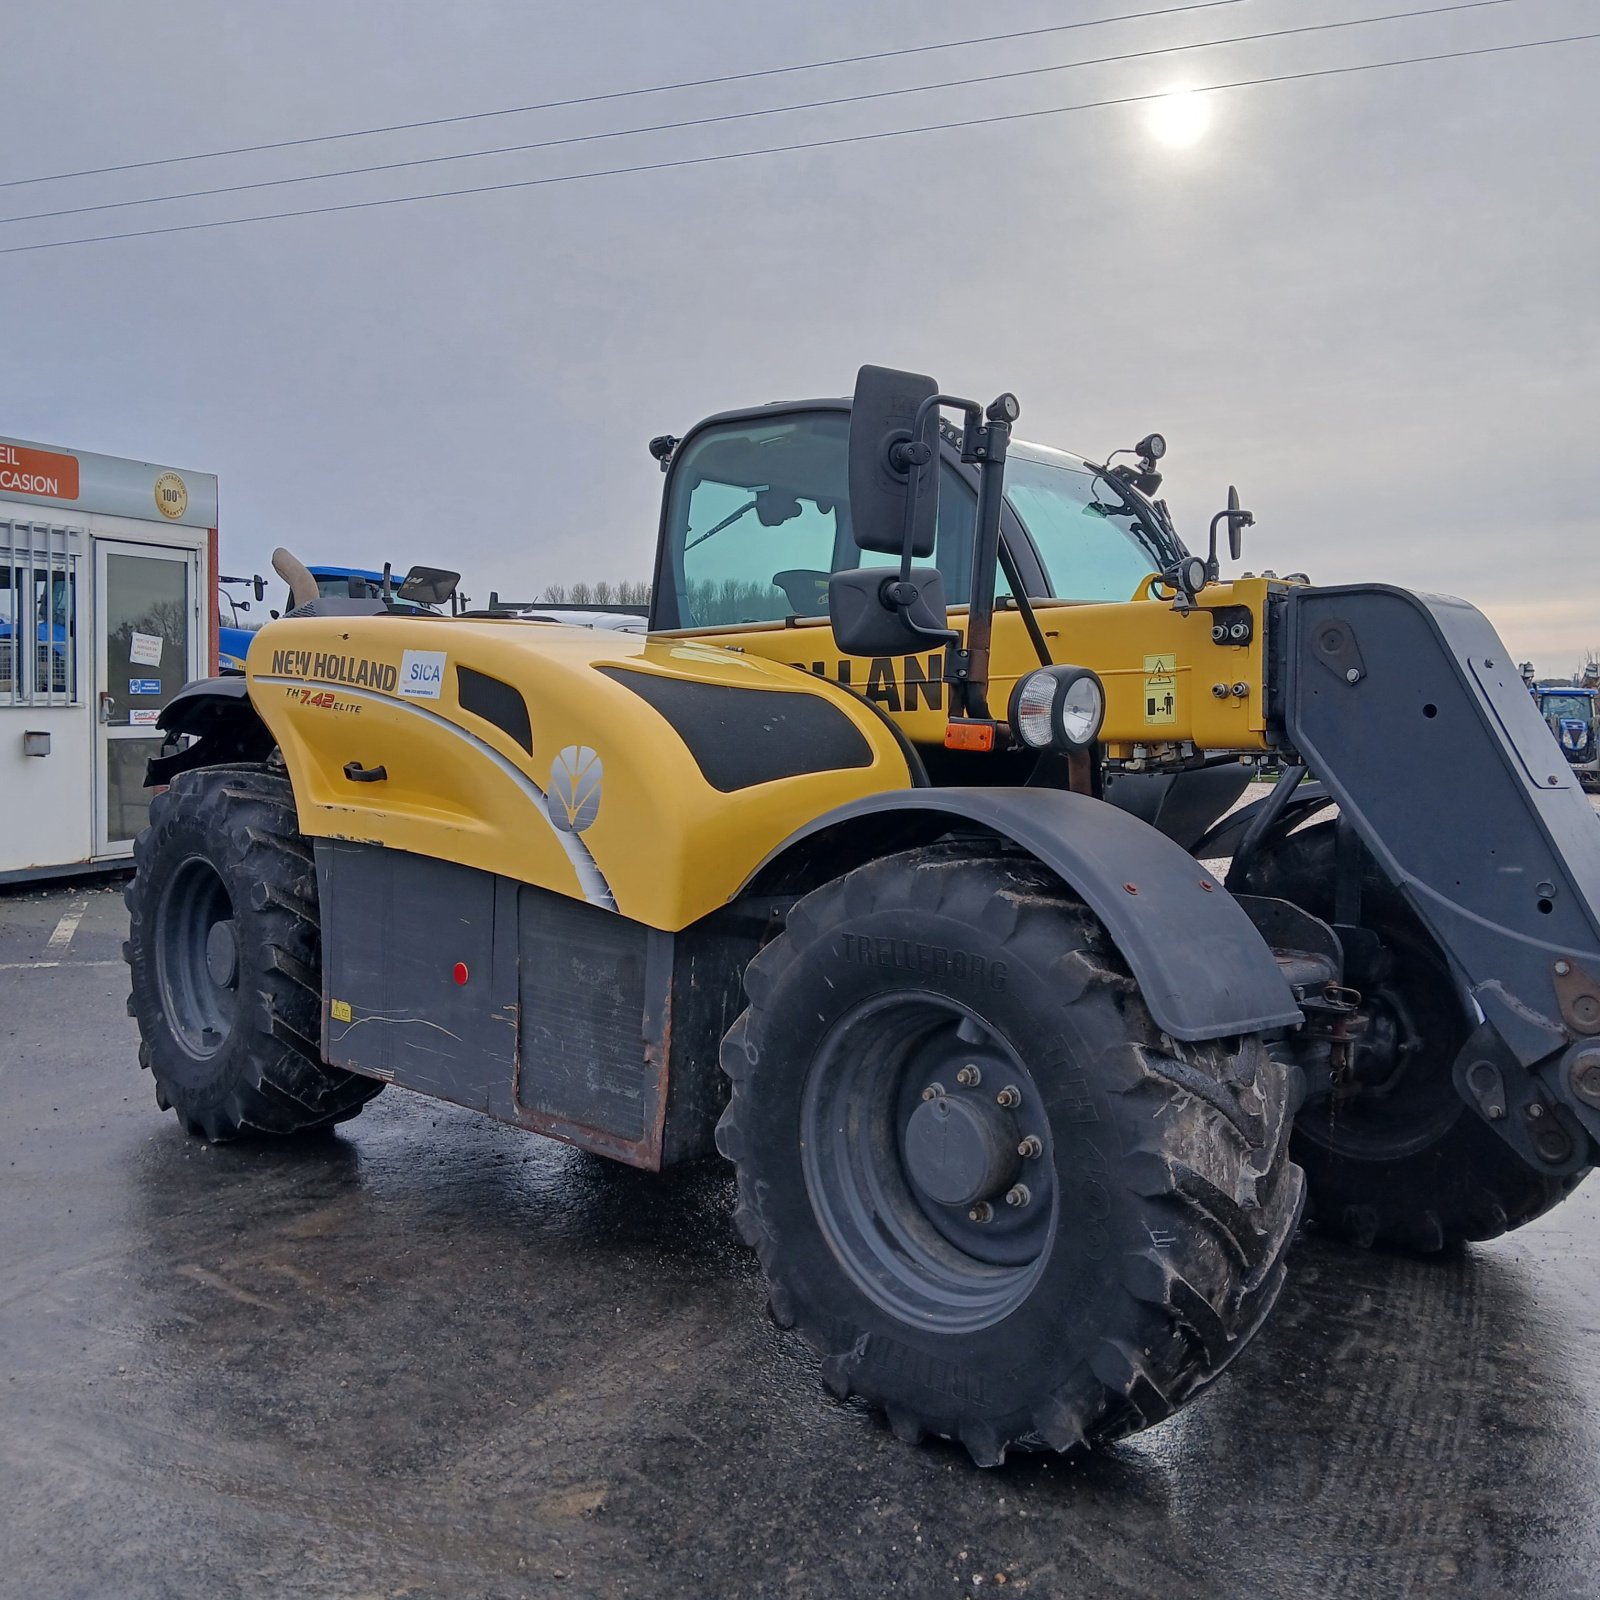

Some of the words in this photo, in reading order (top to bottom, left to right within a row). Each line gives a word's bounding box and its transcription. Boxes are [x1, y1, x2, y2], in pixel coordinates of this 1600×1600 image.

[0, 470, 58, 495] CASION
[162, 488, 182, 503] 100%
[271, 650, 311, 676] NEW
[313, 652, 397, 692] HOLLAND
[410, 663, 440, 682] SICA
[333, 702, 362, 713] ELITE
[840, 930, 1009, 993] TRELLEBORG
